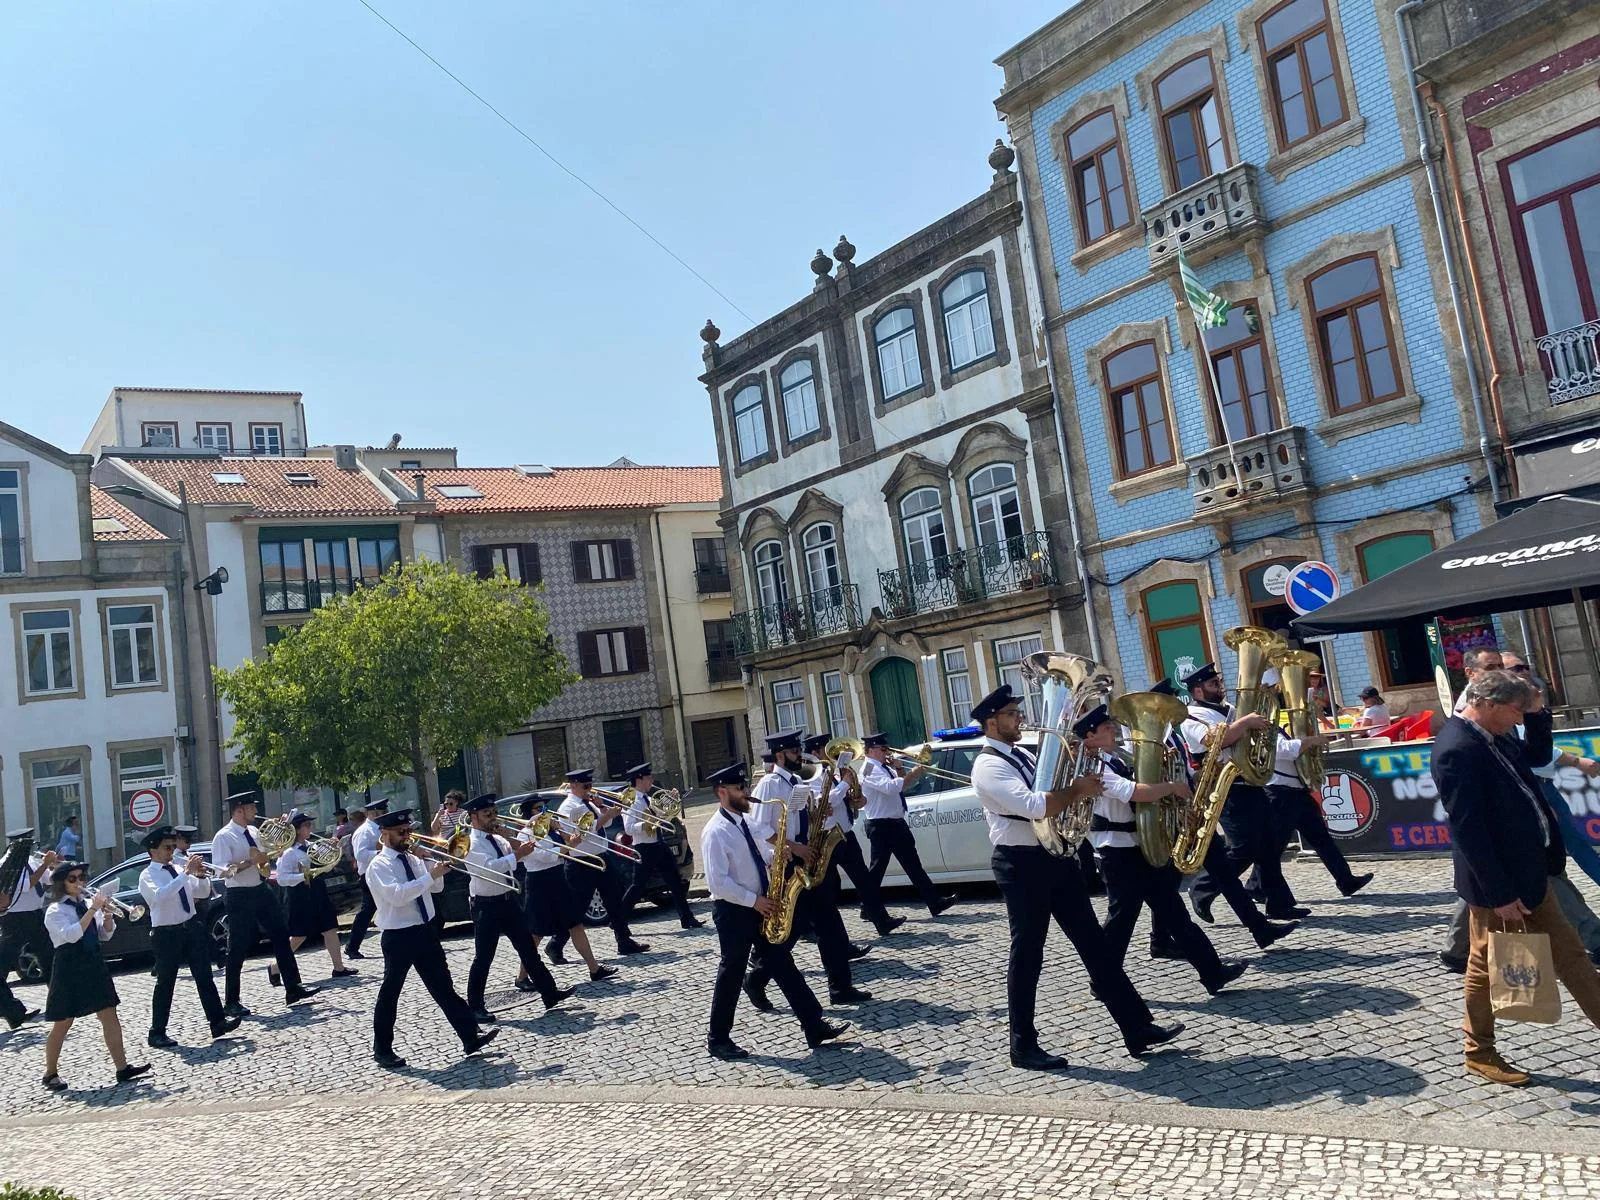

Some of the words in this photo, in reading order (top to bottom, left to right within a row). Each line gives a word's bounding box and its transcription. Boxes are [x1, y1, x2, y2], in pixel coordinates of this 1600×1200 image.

[908, 811, 936, 829] ICIA
[938, 807, 987, 826] MUNICI
[1322, 812, 1365, 822] ncanas
[1391, 826, 1406, 846] E
